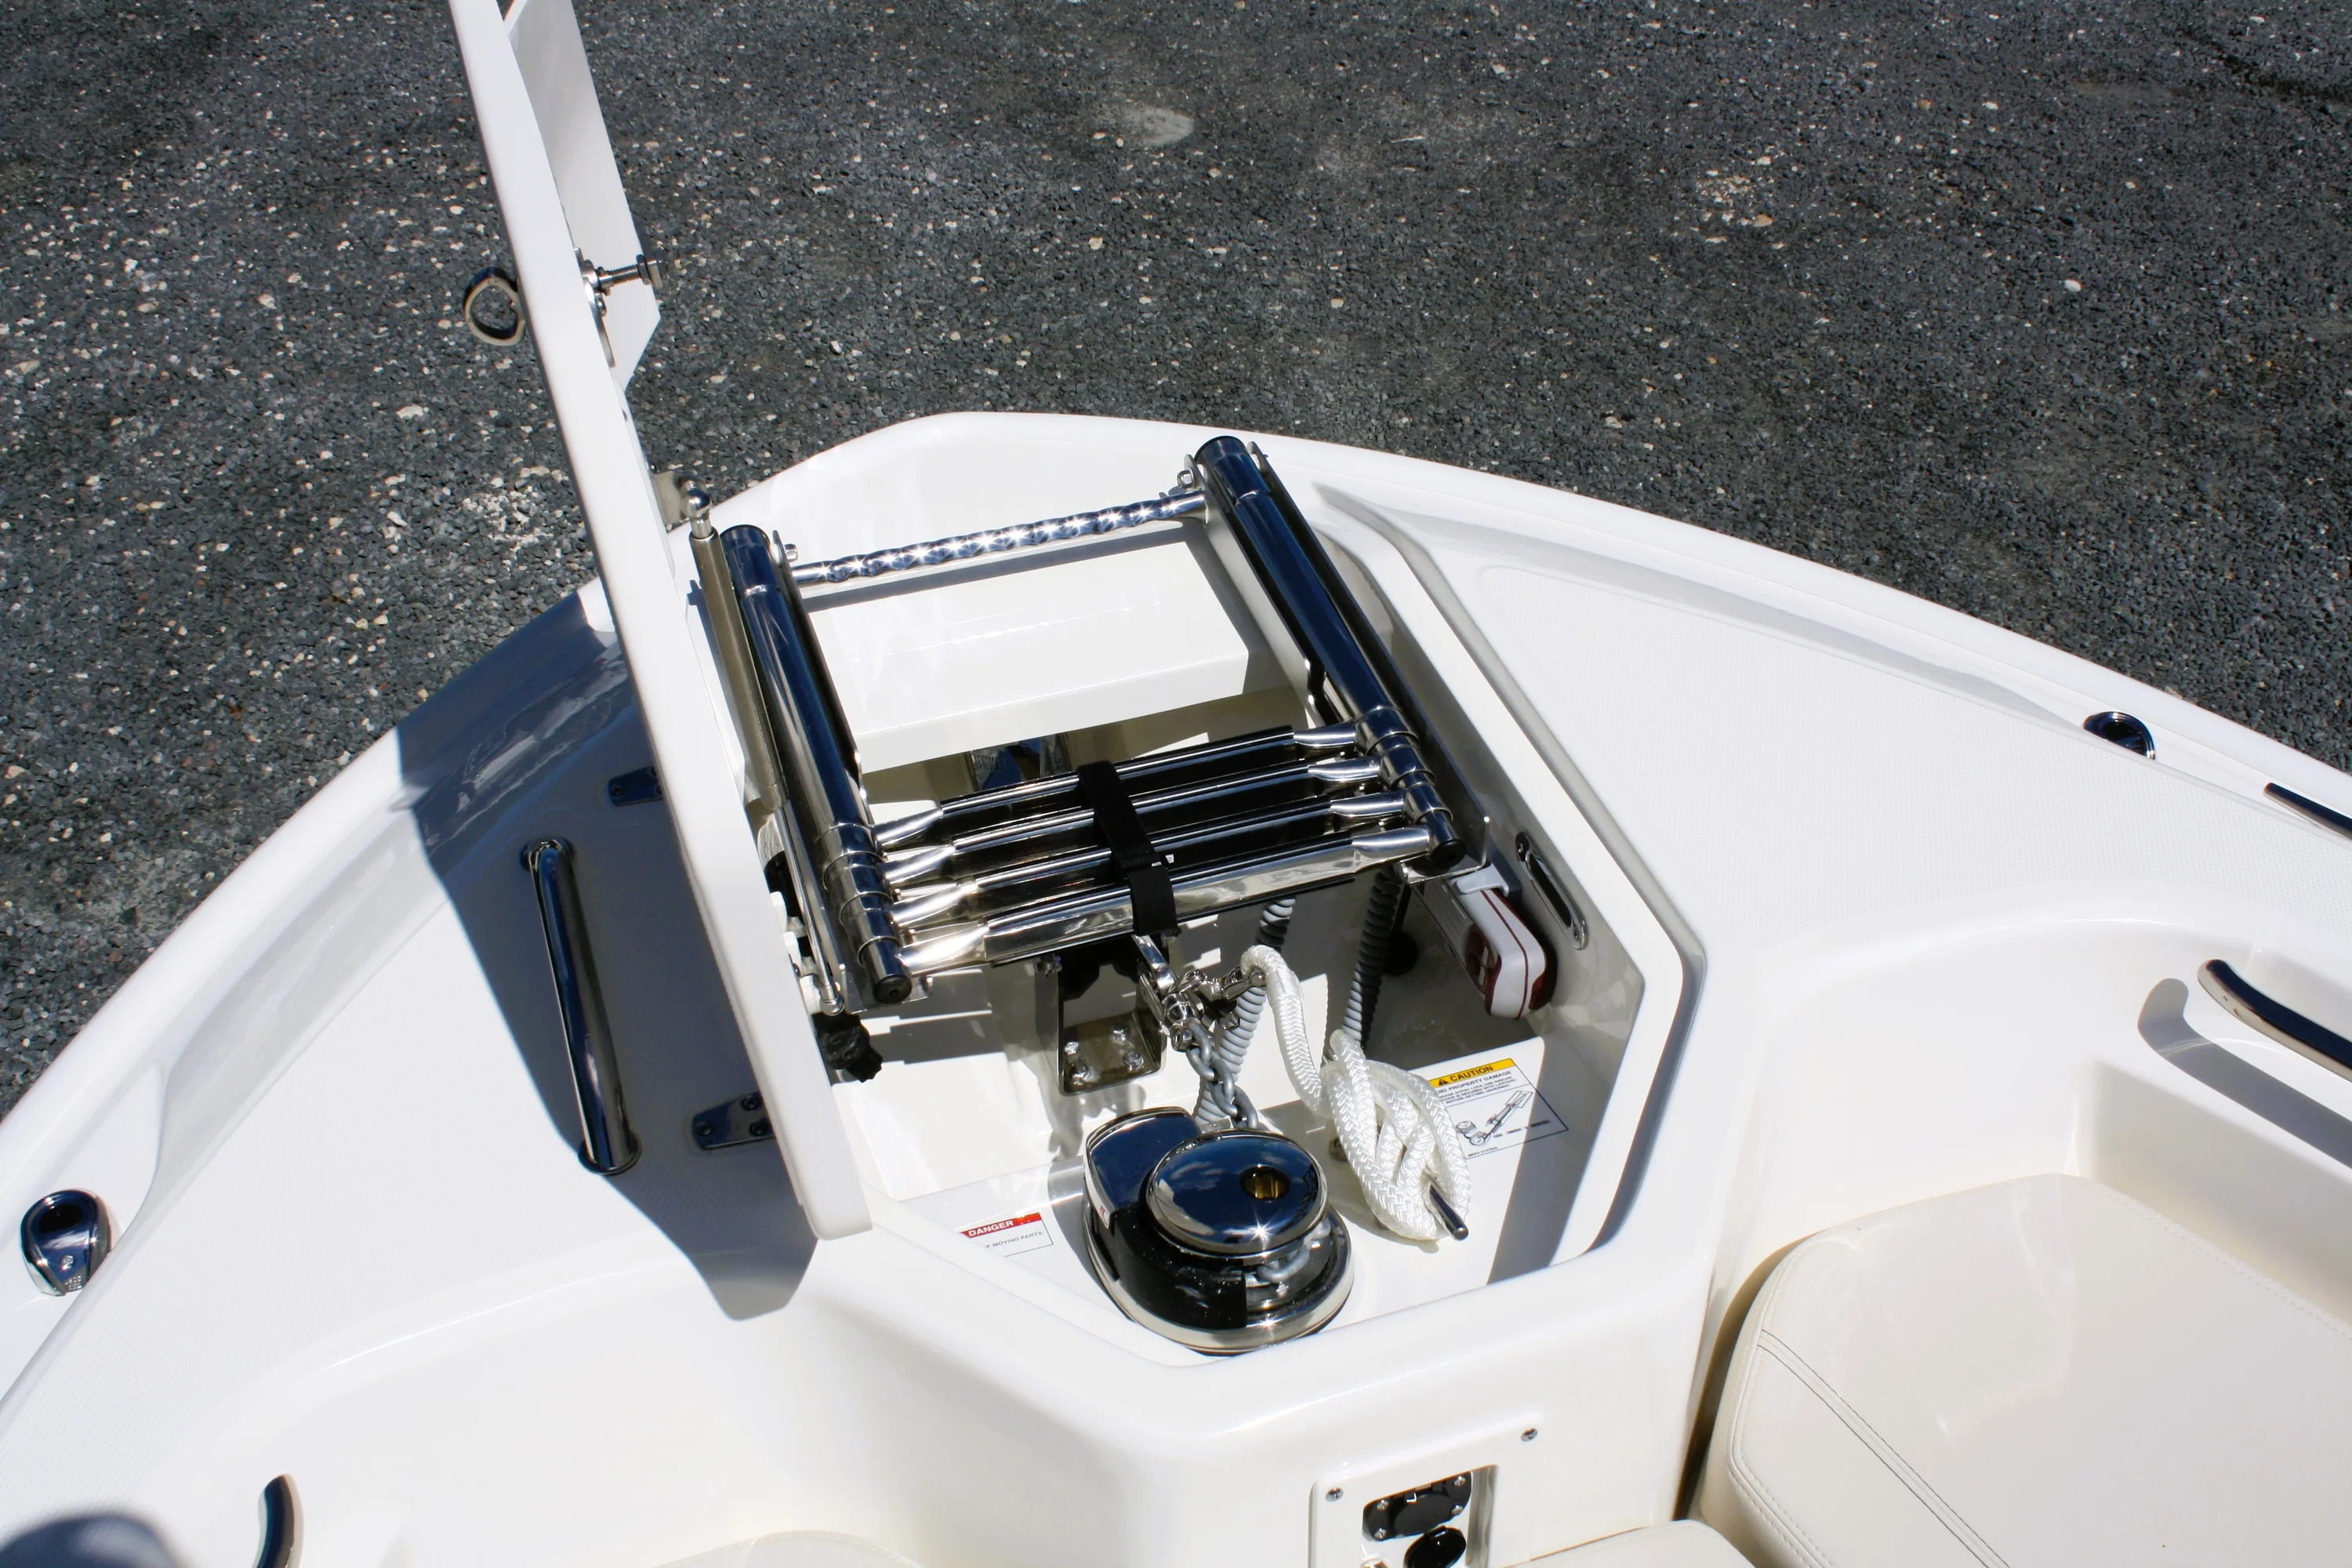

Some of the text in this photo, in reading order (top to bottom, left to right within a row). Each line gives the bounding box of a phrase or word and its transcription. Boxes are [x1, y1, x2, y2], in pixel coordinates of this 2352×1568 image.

[1448, 1078, 1483, 1091] PROPERTY
[1483, 1071, 1512, 1081] DAMAGE
[1450, 1065, 1494, 1082] CAUTION
[968, 1220, 1014, 1237] DANGER
[993, 1237, 1019, 1248] MOVING
[1021, 1231, 1045, 1240] PARTS.
